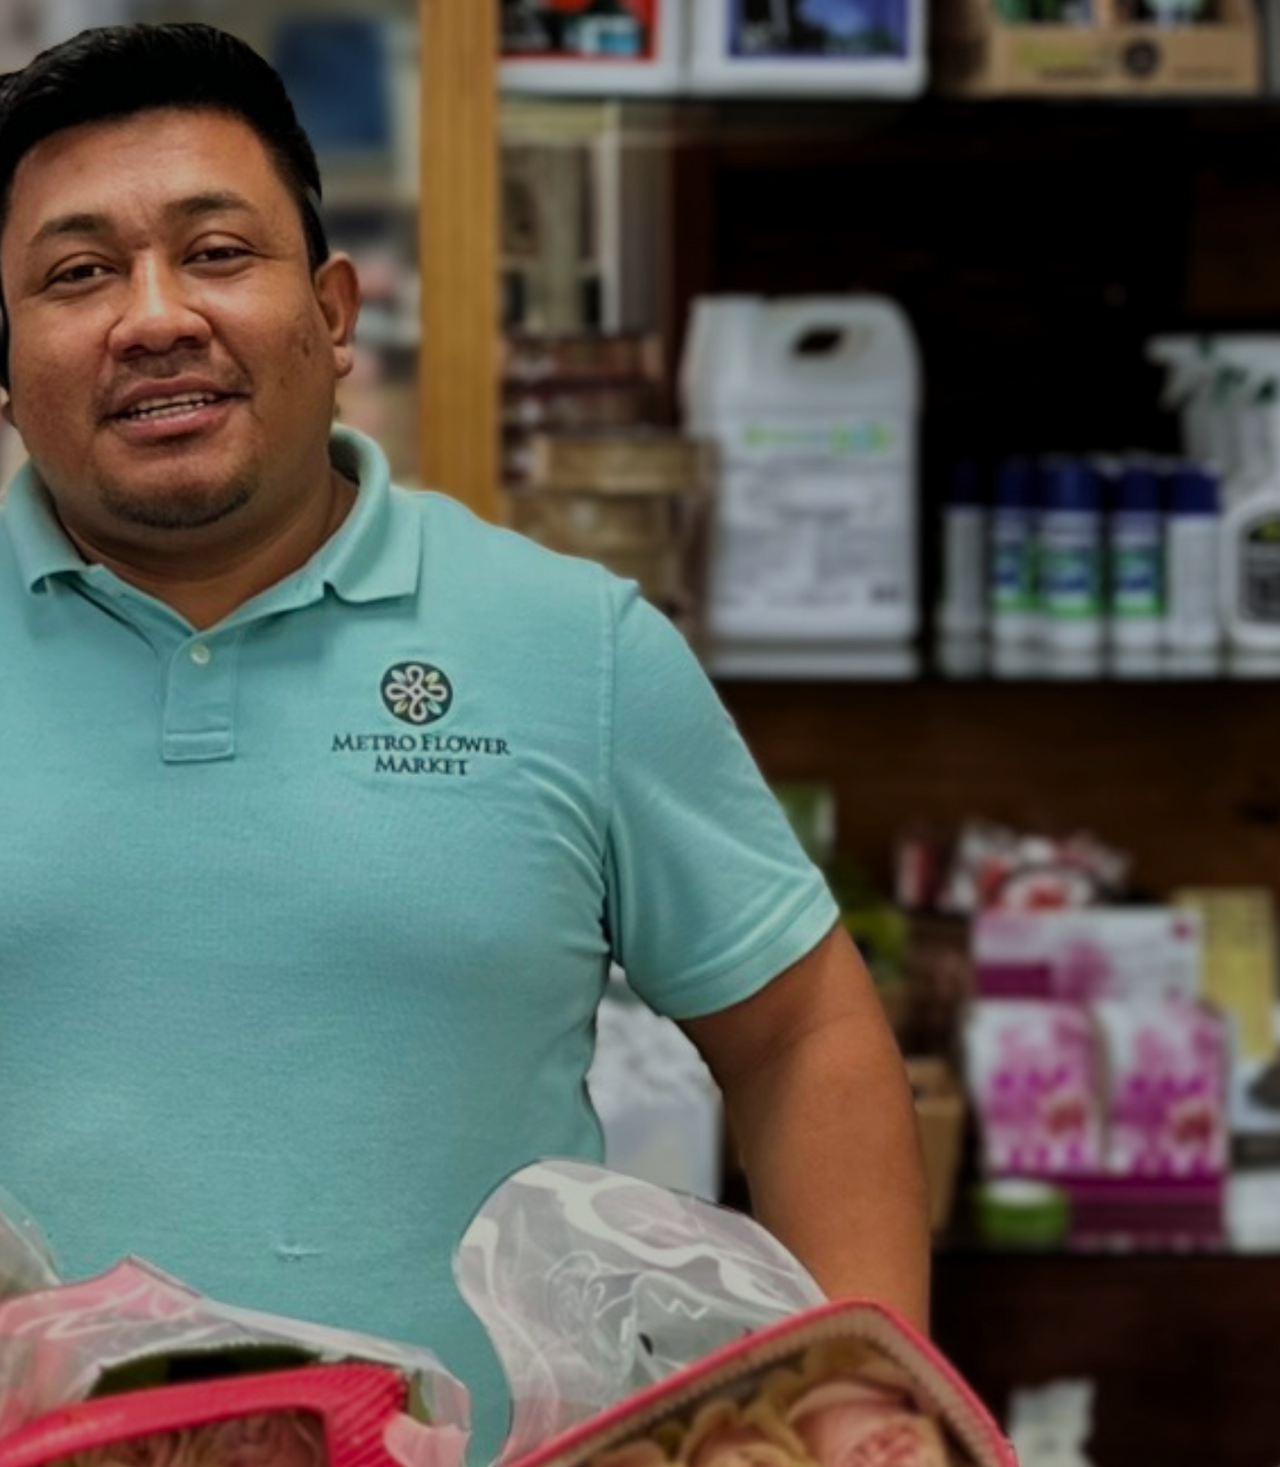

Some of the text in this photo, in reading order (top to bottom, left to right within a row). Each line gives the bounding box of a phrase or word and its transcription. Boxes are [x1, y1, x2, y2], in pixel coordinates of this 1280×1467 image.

[331, 733, 510, 755] METRO FLOWER
[375, 755, 469, 775] MARKET
